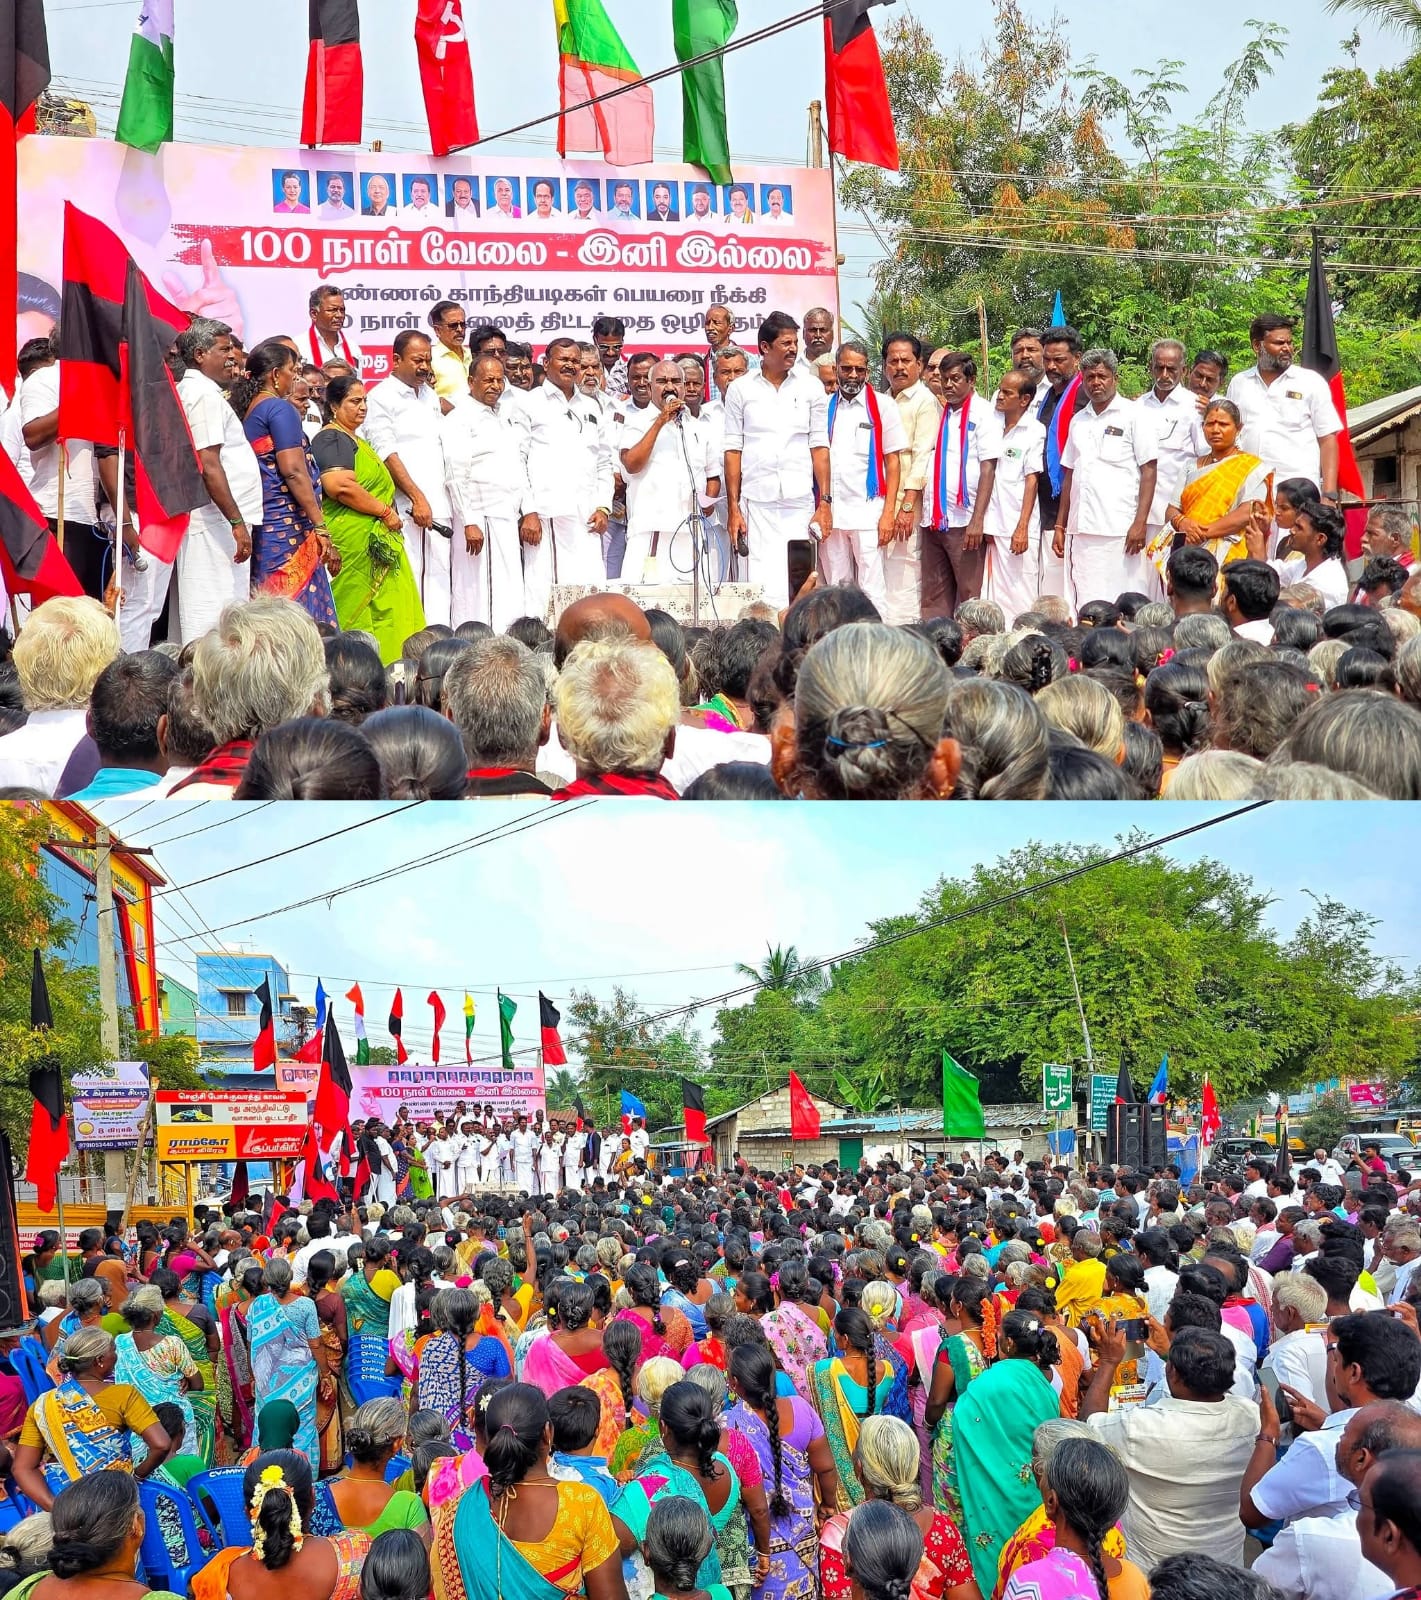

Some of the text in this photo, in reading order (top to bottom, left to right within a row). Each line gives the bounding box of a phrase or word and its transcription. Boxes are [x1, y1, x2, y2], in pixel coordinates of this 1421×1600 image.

[240, 230, 312, 263] 100
[321, 229, 413, 273] நாள்
[420, 231, 547, 266] வேலை
[577, 232, 667, 267] இனி
[676, 235, 813, 270] இல்லை
[341, 283, 767, 306] ண்ணல் காந்தியடிகள் பெயரை நீக்கி
[360, 311, 421, 333] நாள்
[380, 1087, 400, 1096] 100
[402, 1086, 428, 1099] நாள்
[430, 1086, 467, 1097] வேலை
[474, 1086, 499, 1097] இனி
[501, 1086, 539, 1097] இல்லை
